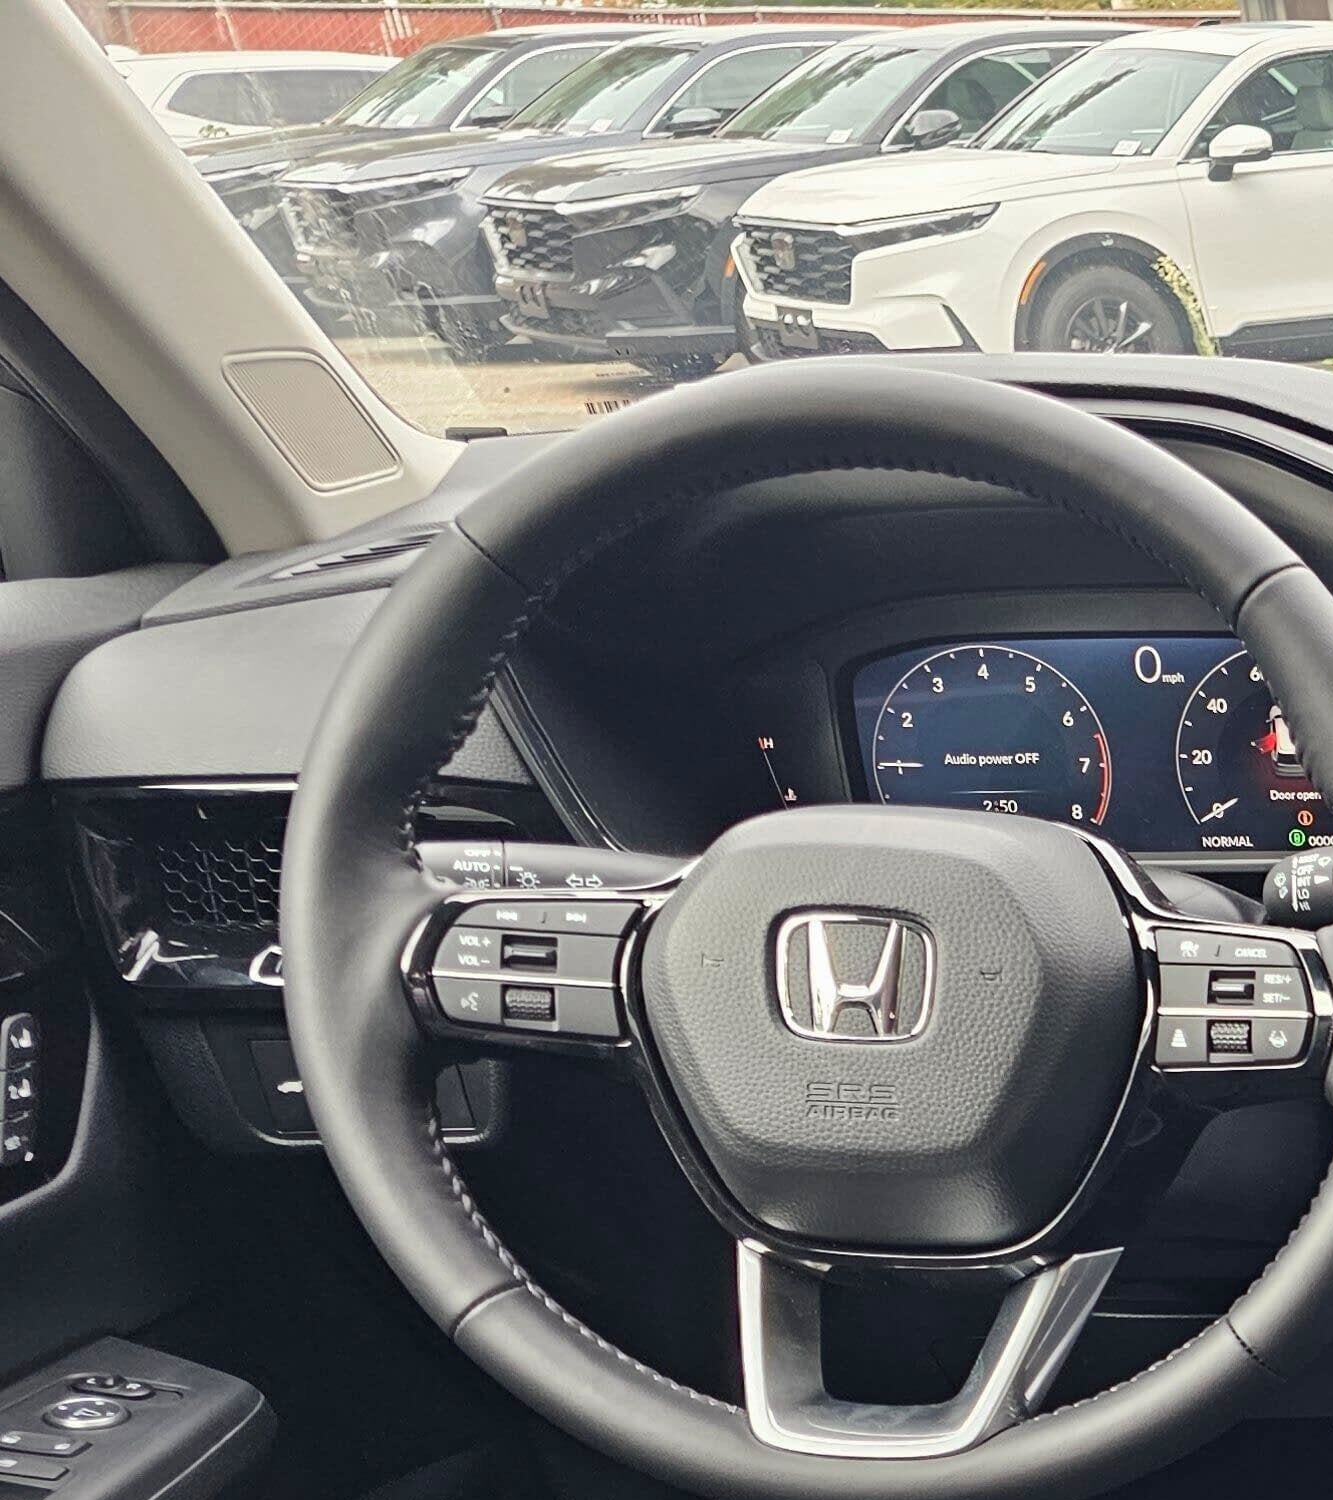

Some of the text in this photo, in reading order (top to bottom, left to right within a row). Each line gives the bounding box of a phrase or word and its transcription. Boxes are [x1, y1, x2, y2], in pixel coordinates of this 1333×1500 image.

[977, 664, 989, 680] 4
[1134, 645, 1185, 684] 0 mph
[932, 677, 944, 693] 3
[1025, 676, 1036, 693] 5
[1206, 698, 1227, 713] 40
[901, 712, 914, 728] 2
[1062, 711, 1074, 727] 6
[944, 753, 1040, 767] Audio power OFF
[1192, 749, 1212, 765] 20
[1078, 757, 1090, 774] 7
[1269, 789, 1295, 801] Door
[983, 800, 1018, 813] 2:50
[1071, 804, 1083, 820] 8
[1201, 835, 1254, 848] NORMAL
[453, 860, 490, 872] AUTO
[1297, 865, 1314, 875] OFF
[1297, 876, 1312, 887] INT
[1297, 888, 1310, 900] LO
[1299, 901, 1311, 911] HI
[806, 1081, 896, 1102] SRS
[805, 1104, 900, 1120] AIRBAG
